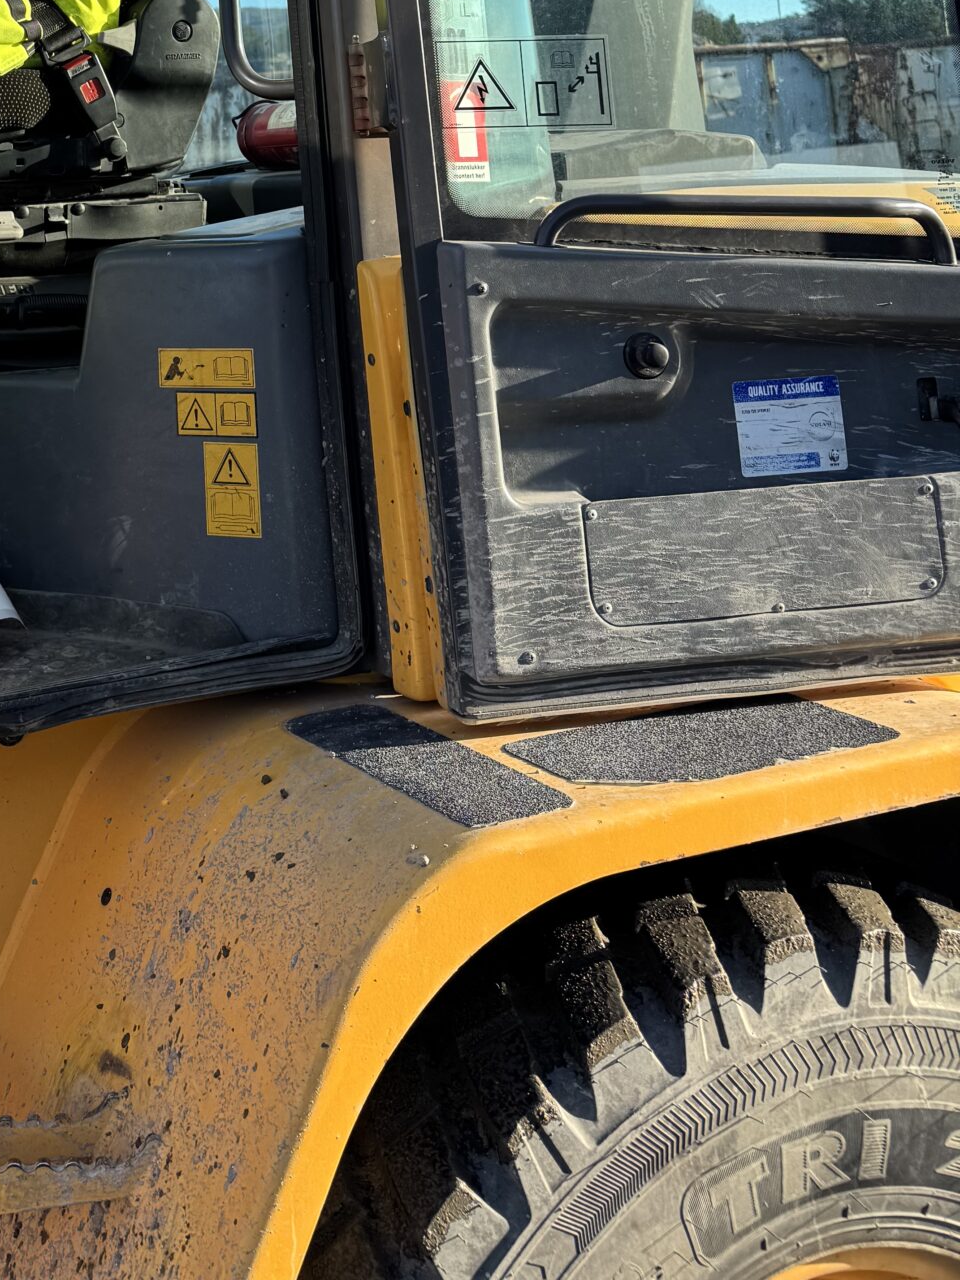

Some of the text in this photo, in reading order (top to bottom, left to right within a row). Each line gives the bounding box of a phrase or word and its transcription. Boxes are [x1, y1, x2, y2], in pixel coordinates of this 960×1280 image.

[748, 381, 824, 397] QUALITY ASSURANCE
[707, 1118, 891, 1235] TRI
